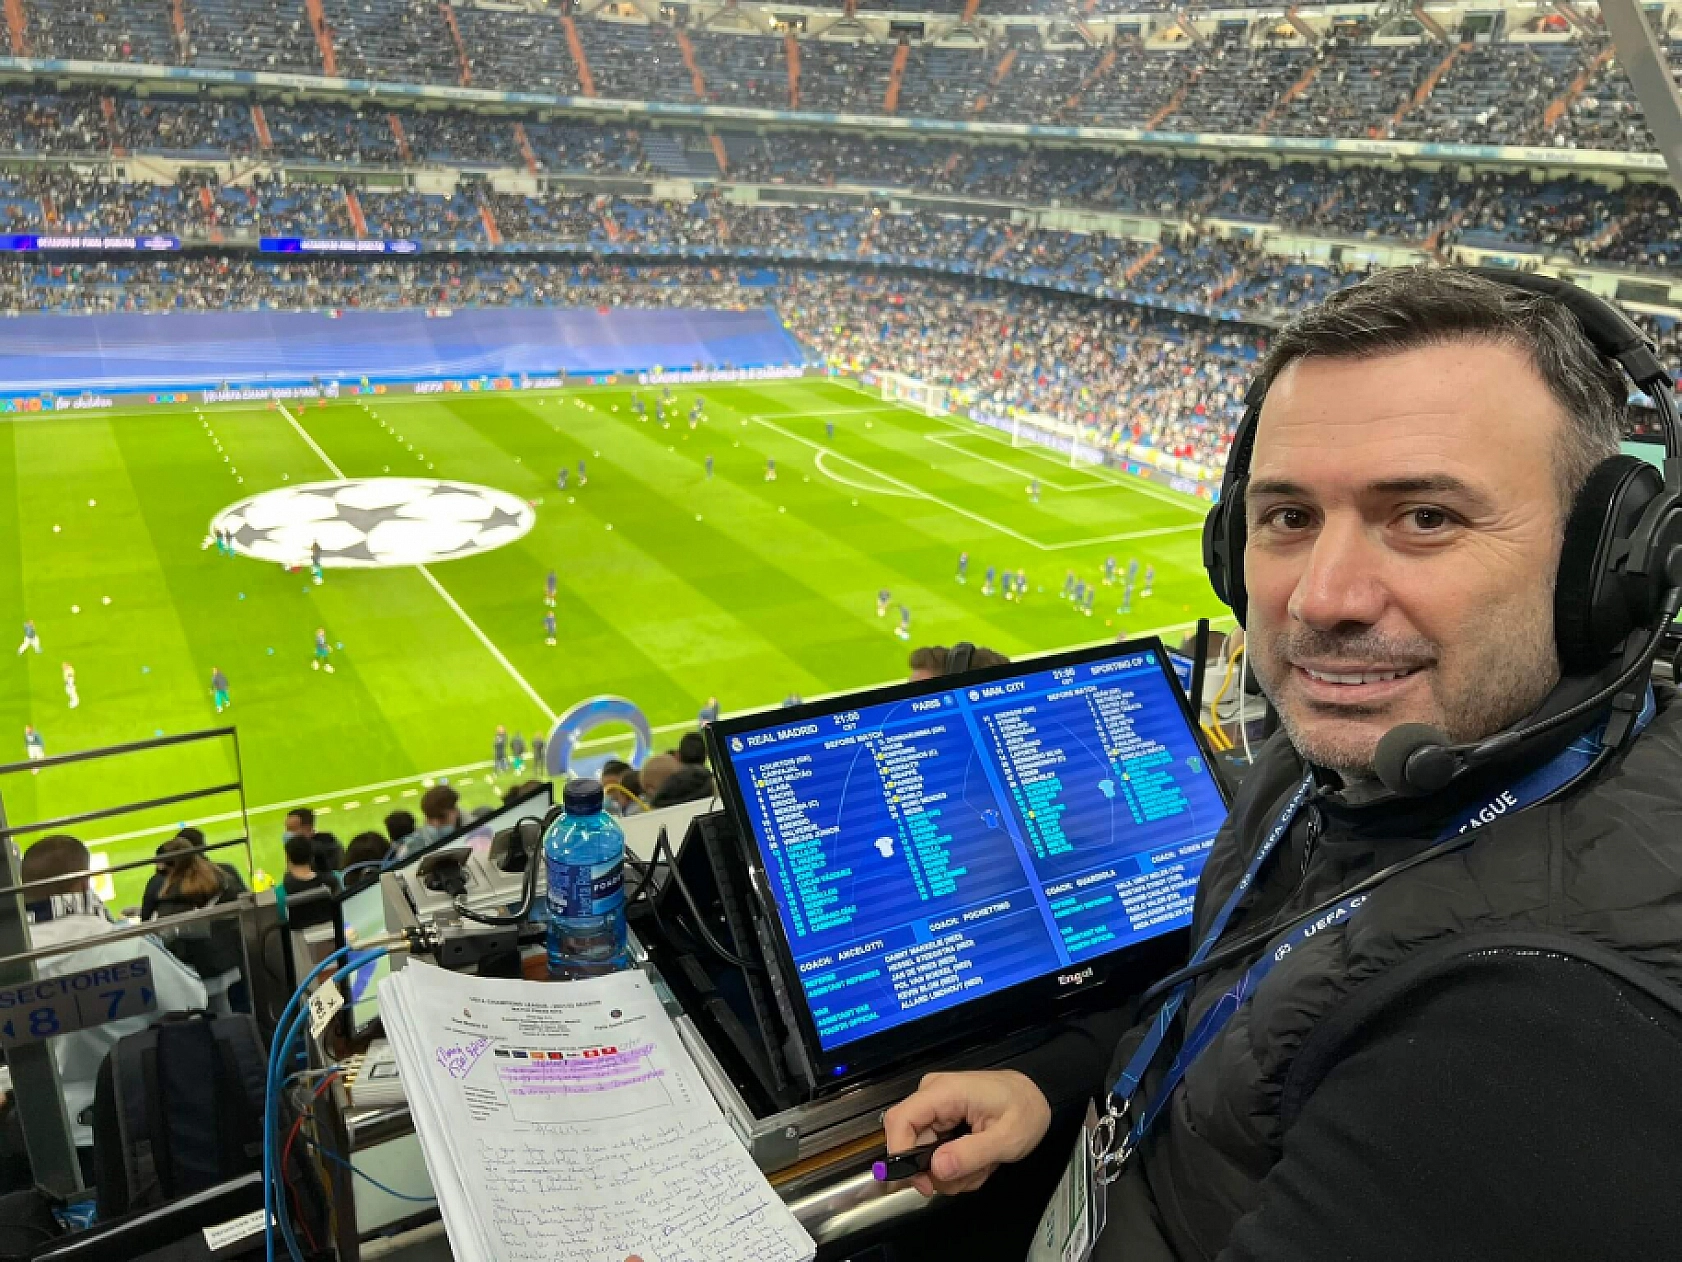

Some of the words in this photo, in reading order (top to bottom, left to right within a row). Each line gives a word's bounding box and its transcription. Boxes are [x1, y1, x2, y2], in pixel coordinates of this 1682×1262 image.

[833, 711, 860, 725] 21:00
[911, 699, 941, 713] PARIS
[747, 732, 777, 747] REAL
[778, 724, 818, 740] MADRID
[929, 916, 960, 932] COACH:
[1304, 908, 1348, 938] UEFA
[800, 956, 834, 973] COACH:
[838, 940, 884, 961] ANCELOTTI
[0, 961, 147, 1009] SECTORES
[29, 1007, 60, 1036] 8
[99, 989, 126, 1020] 7
